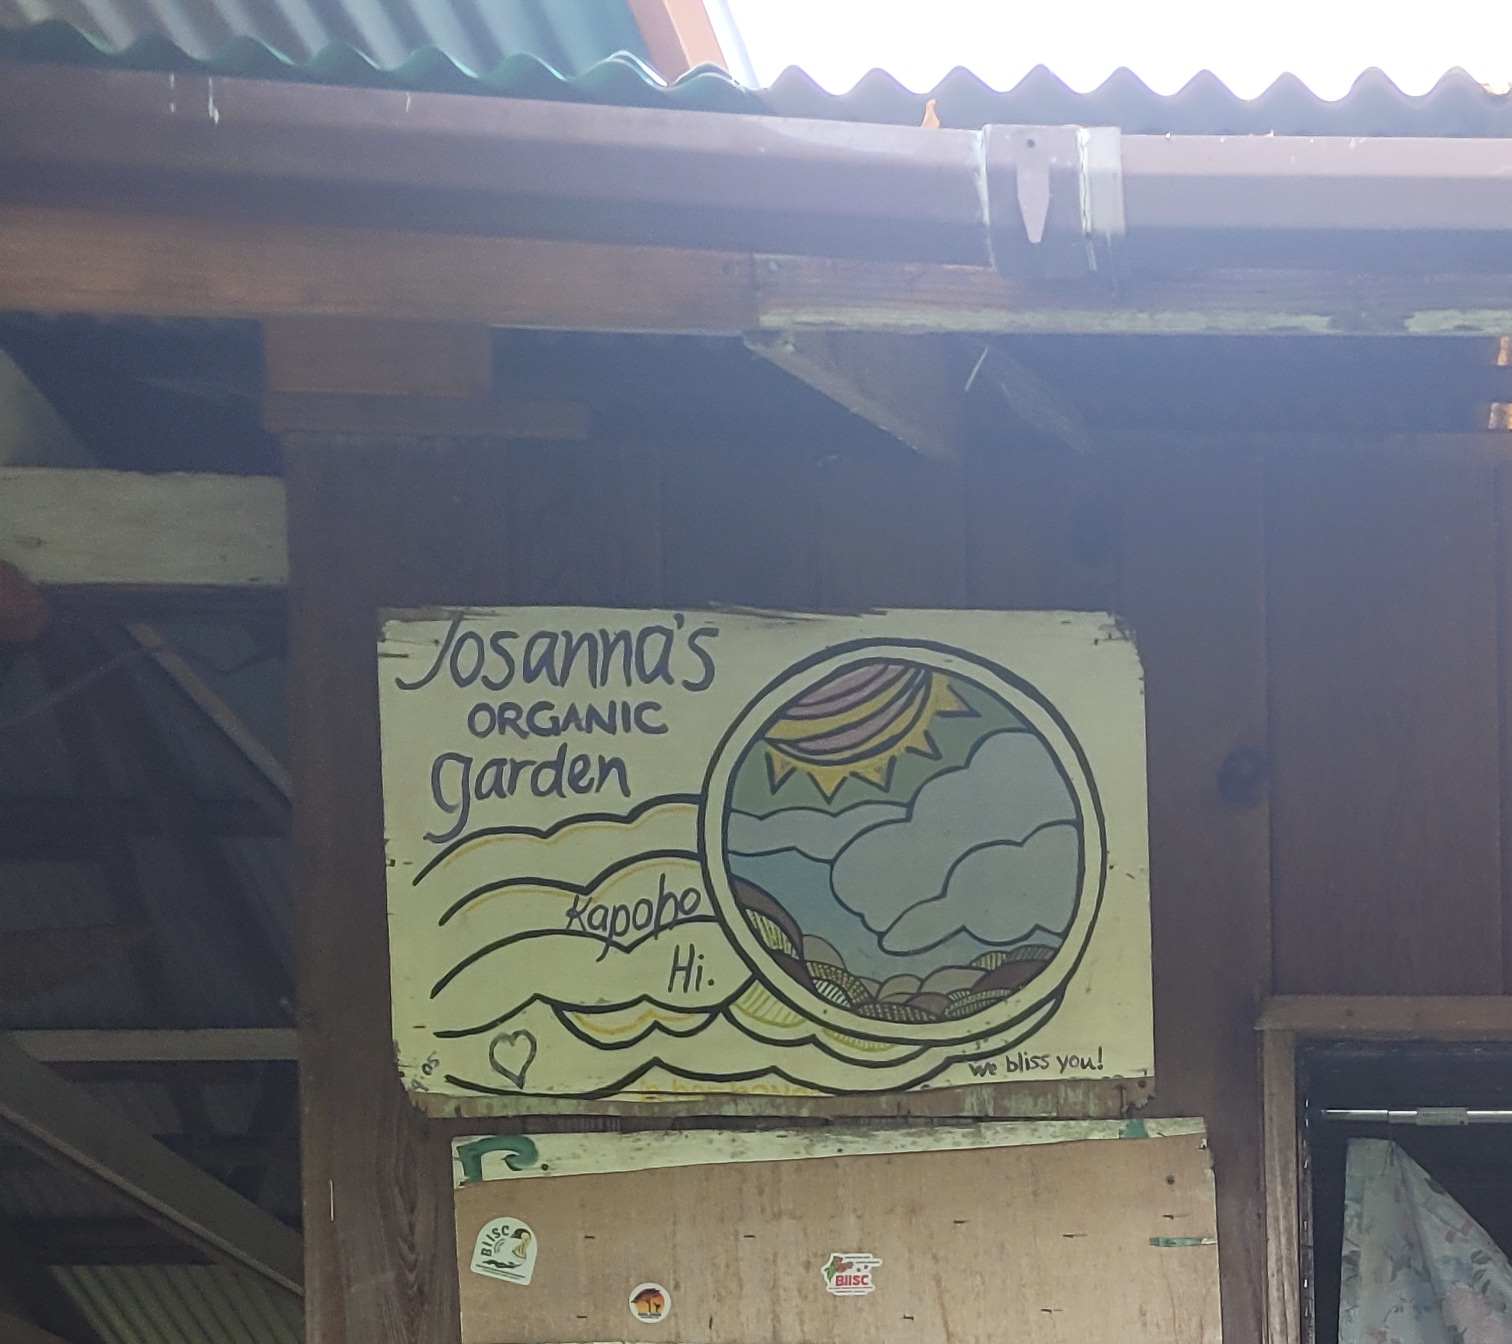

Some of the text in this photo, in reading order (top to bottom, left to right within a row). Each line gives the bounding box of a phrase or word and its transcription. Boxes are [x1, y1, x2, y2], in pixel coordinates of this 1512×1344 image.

[397, 609, 719, 692] Josanna's
[467, 700, 669, 738] ORGANIC
[424, 744, 631, 842] garden
[668, 943, 716, 993] Hi.
[969, 1045, 1104, 1078] we bliss you!
[835, 1274, 870, 1287] BIISC
